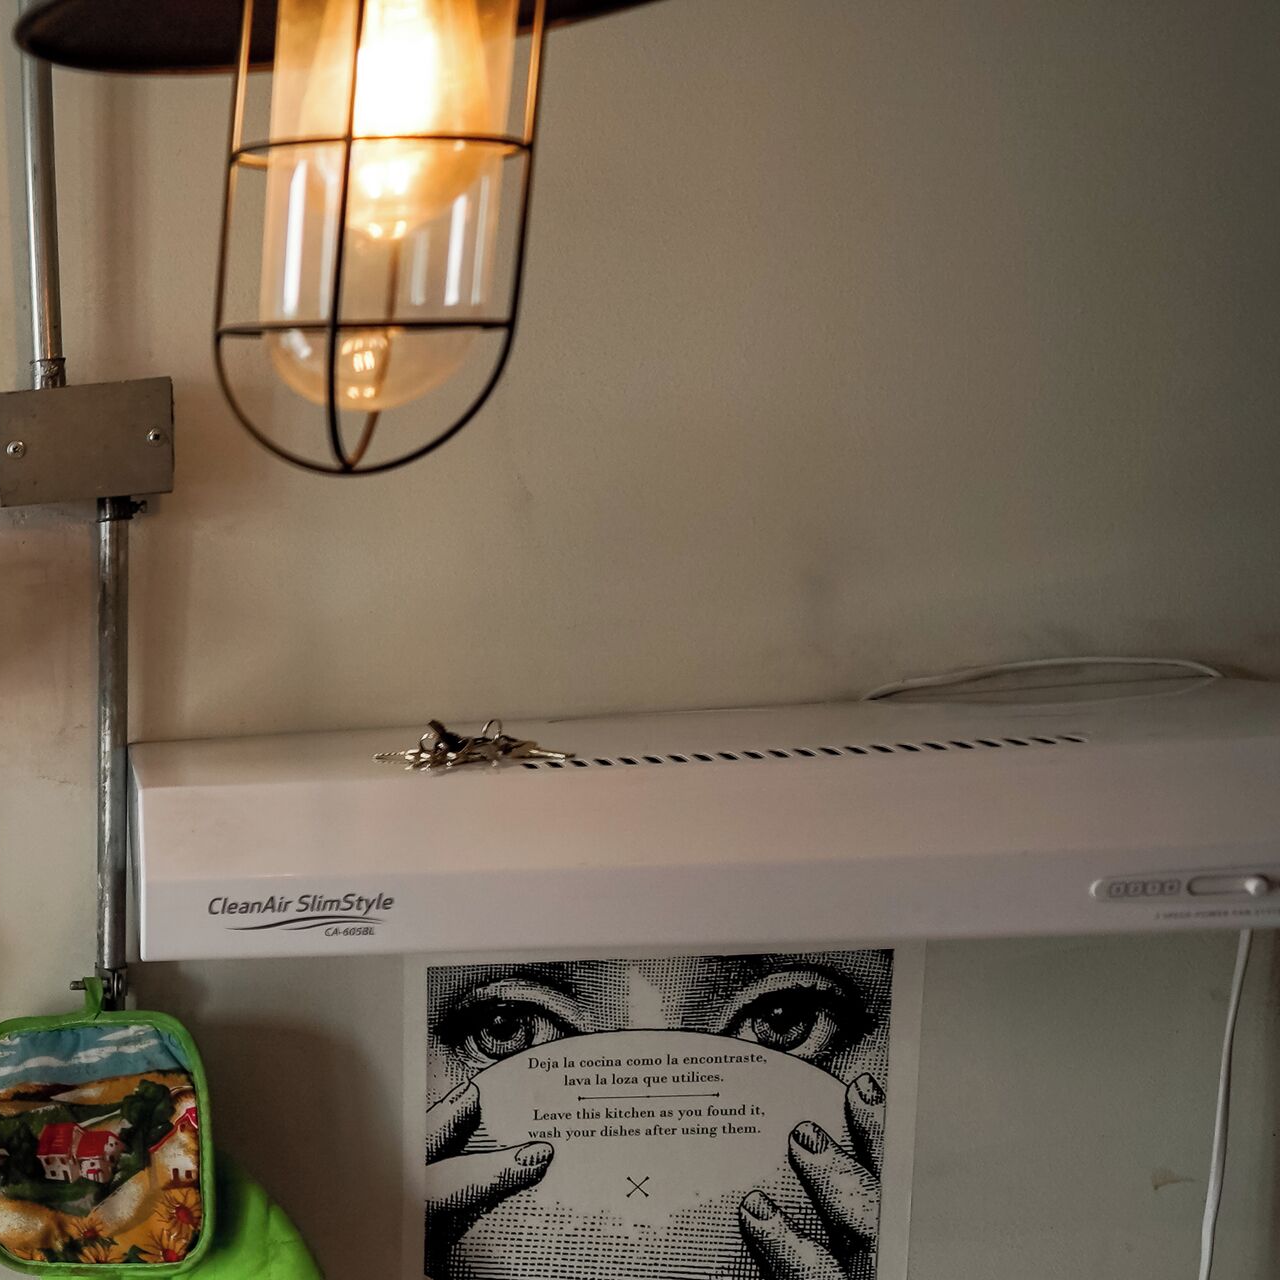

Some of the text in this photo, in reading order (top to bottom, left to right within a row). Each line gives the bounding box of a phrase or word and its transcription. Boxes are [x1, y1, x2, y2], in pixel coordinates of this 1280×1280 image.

[207, 892, 396, 916] CleanAir SlimStyle
[527, 1053, 768, 1072] Deja la cocina como la encontraste,
[564, 1071, 724, 1087] lava la loza que utilices.
[533, 1104, 765, 1121] Leave this kitchen as you found it,
[528, 1122, 761, 1141] wash your dishes after using them.
